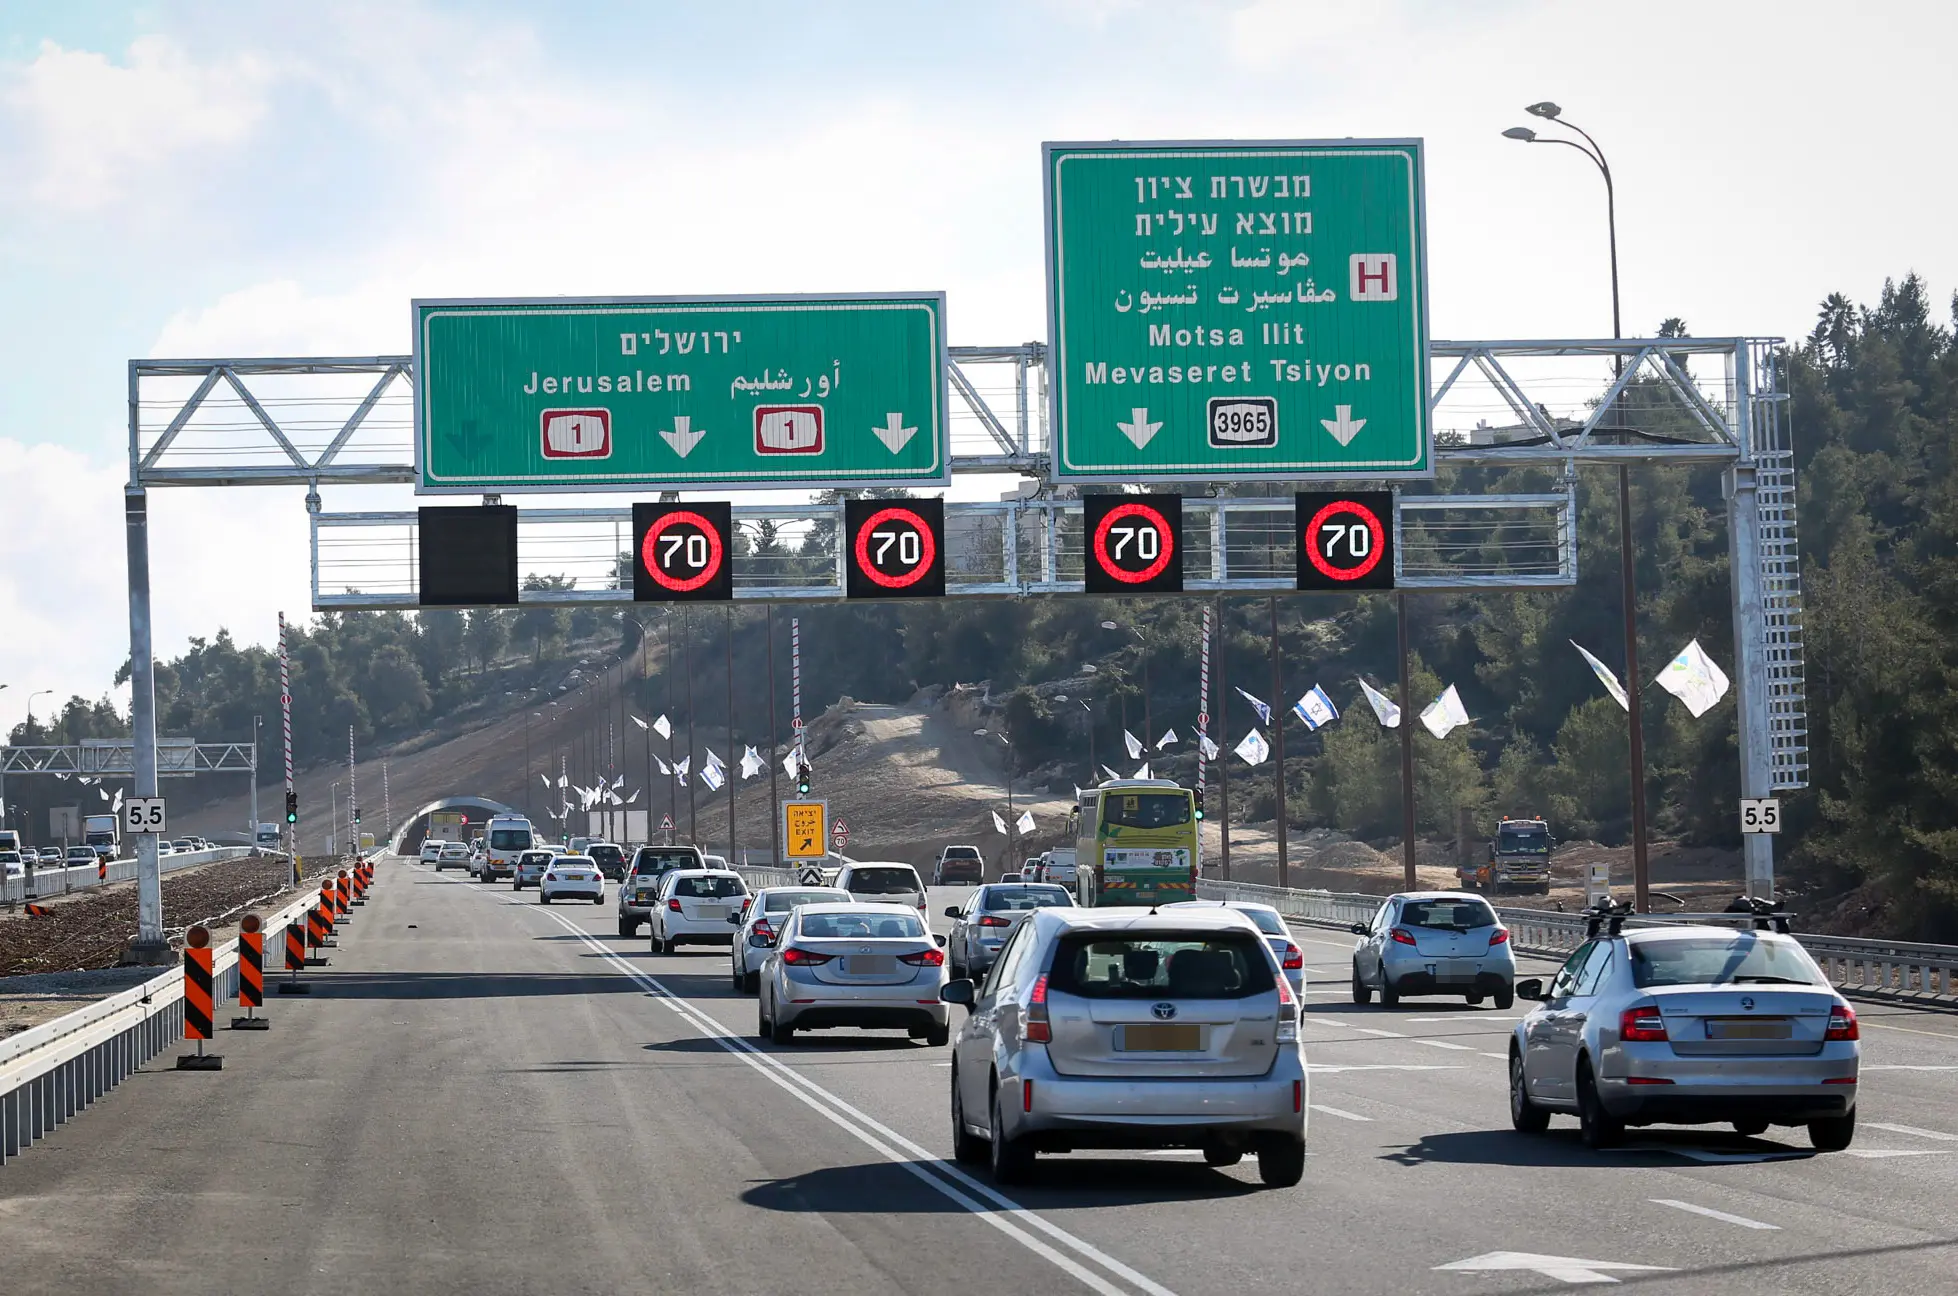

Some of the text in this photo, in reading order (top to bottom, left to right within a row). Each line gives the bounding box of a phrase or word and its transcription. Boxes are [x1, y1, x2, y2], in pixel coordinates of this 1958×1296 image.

[1135, 175, 1311, 203] מבשרת ציון
[1135, 209, 1312, 236] מוצא עילית
[1140, 246, 1310, 276] موتسا عيليت
[1358, 261, 1389, 294] H
[1114, 284, 1198, 314] تسيون
[620, 328, 741, 355] ירושלים
[1149, 322, 1304, 347] Motsa Ilit
[523, 370, 691, 395] Jerusalem
[730, 359, 840, 400] أورشليم
[1085, 359, 1371, 387] Mevaseret Tsiyon
[571, 423, 581, 445] 1
[784, 419, 794, 441] 1
[1217, 411, 1268, 434] 3965
[659, 534, 707, 568] 70
[872, 531, 920, 565] 70
[1110, 526, 1158, 560] 70
[1321, 524, 1369, 558] 70
[130, 806, 162, 825] 5.5
[1745, 806, 1776, 825] 5.5
